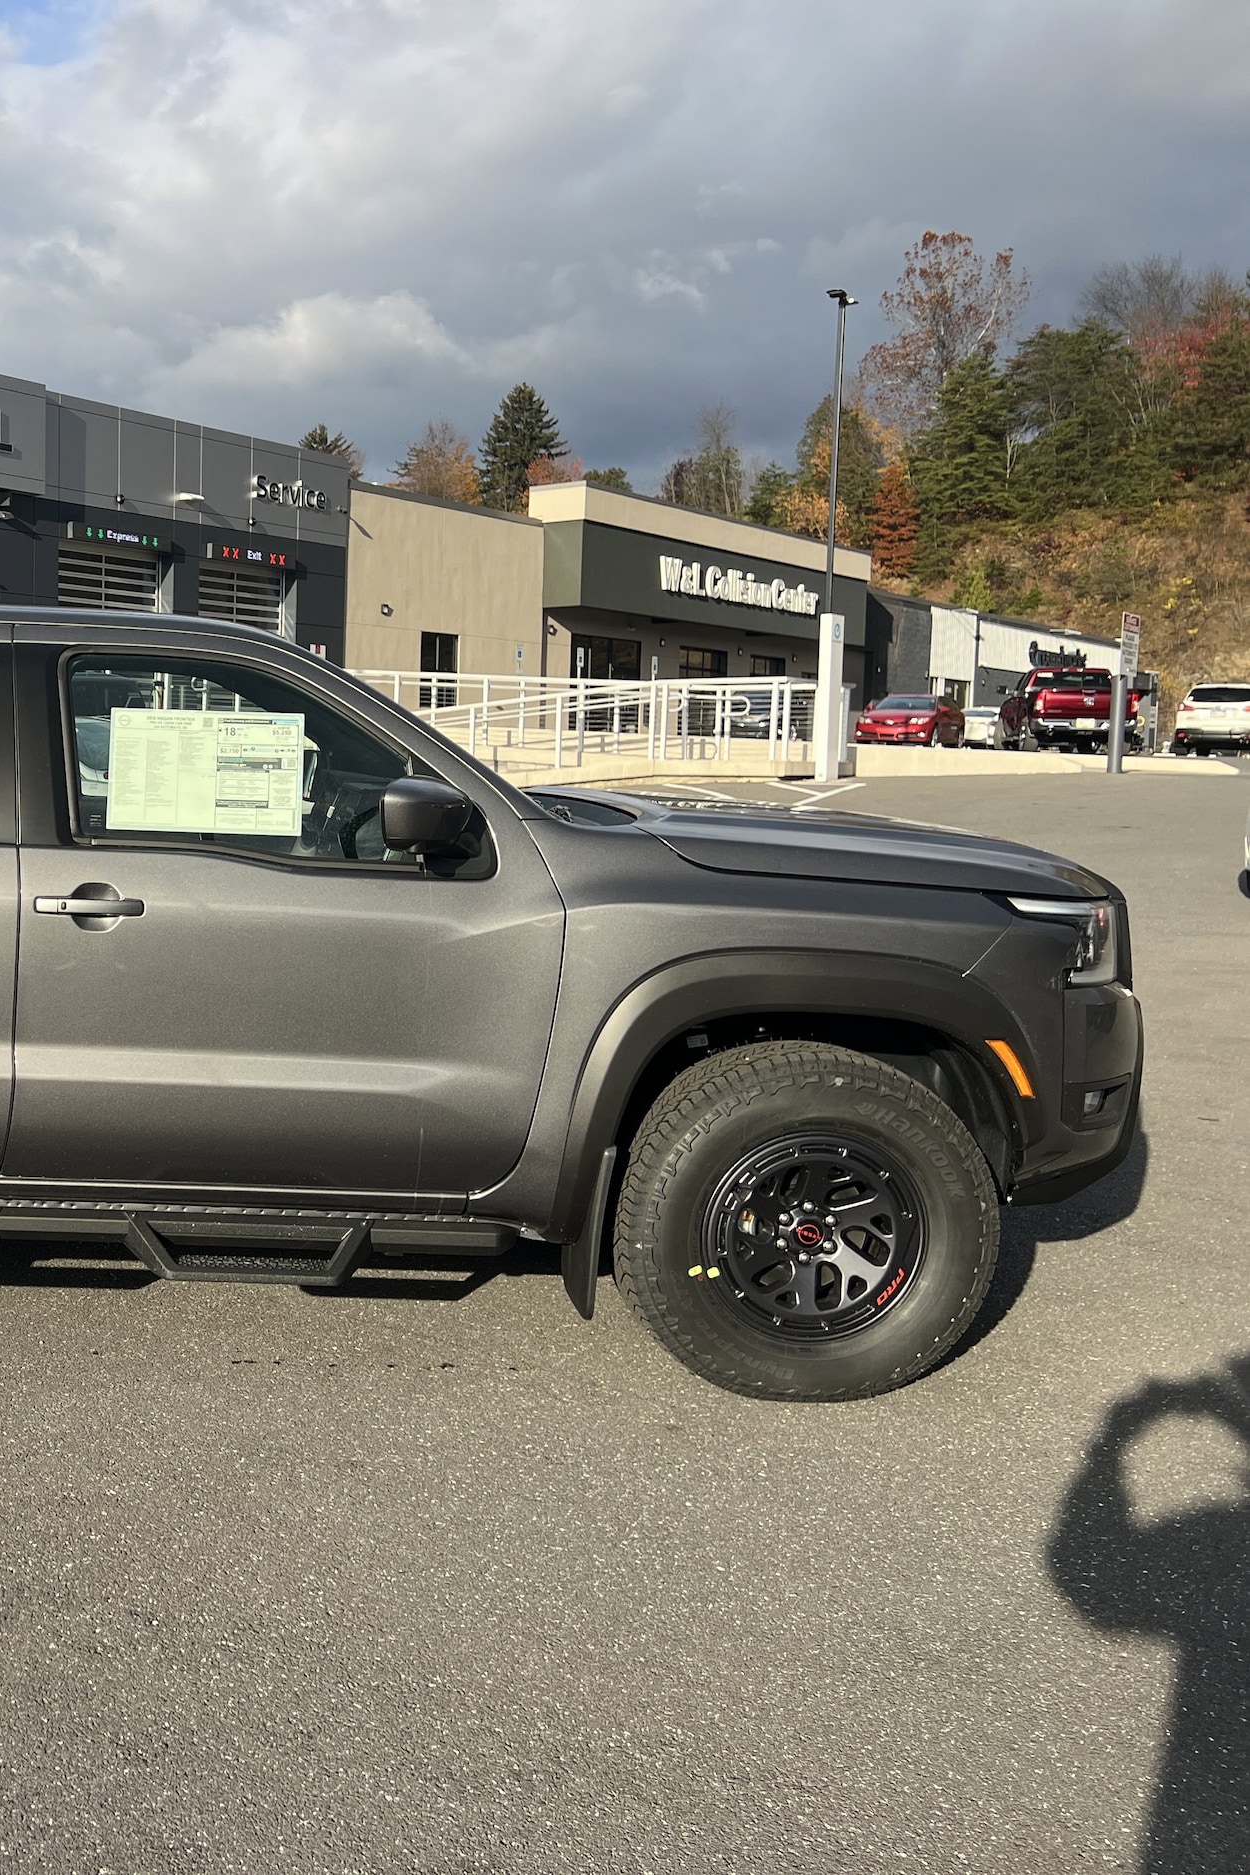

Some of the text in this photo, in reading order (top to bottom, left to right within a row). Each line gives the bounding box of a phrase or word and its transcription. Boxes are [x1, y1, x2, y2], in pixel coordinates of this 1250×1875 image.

[252, 475, 326, 510] Service
[107, 530, 139, 543] Express
[247, 550, 262, 561] Exit
[659, 555, 819, 615] W&L Collision Center
[224, 727, 236, 736] 18
[876, 1267, 905, 1306] PRO
